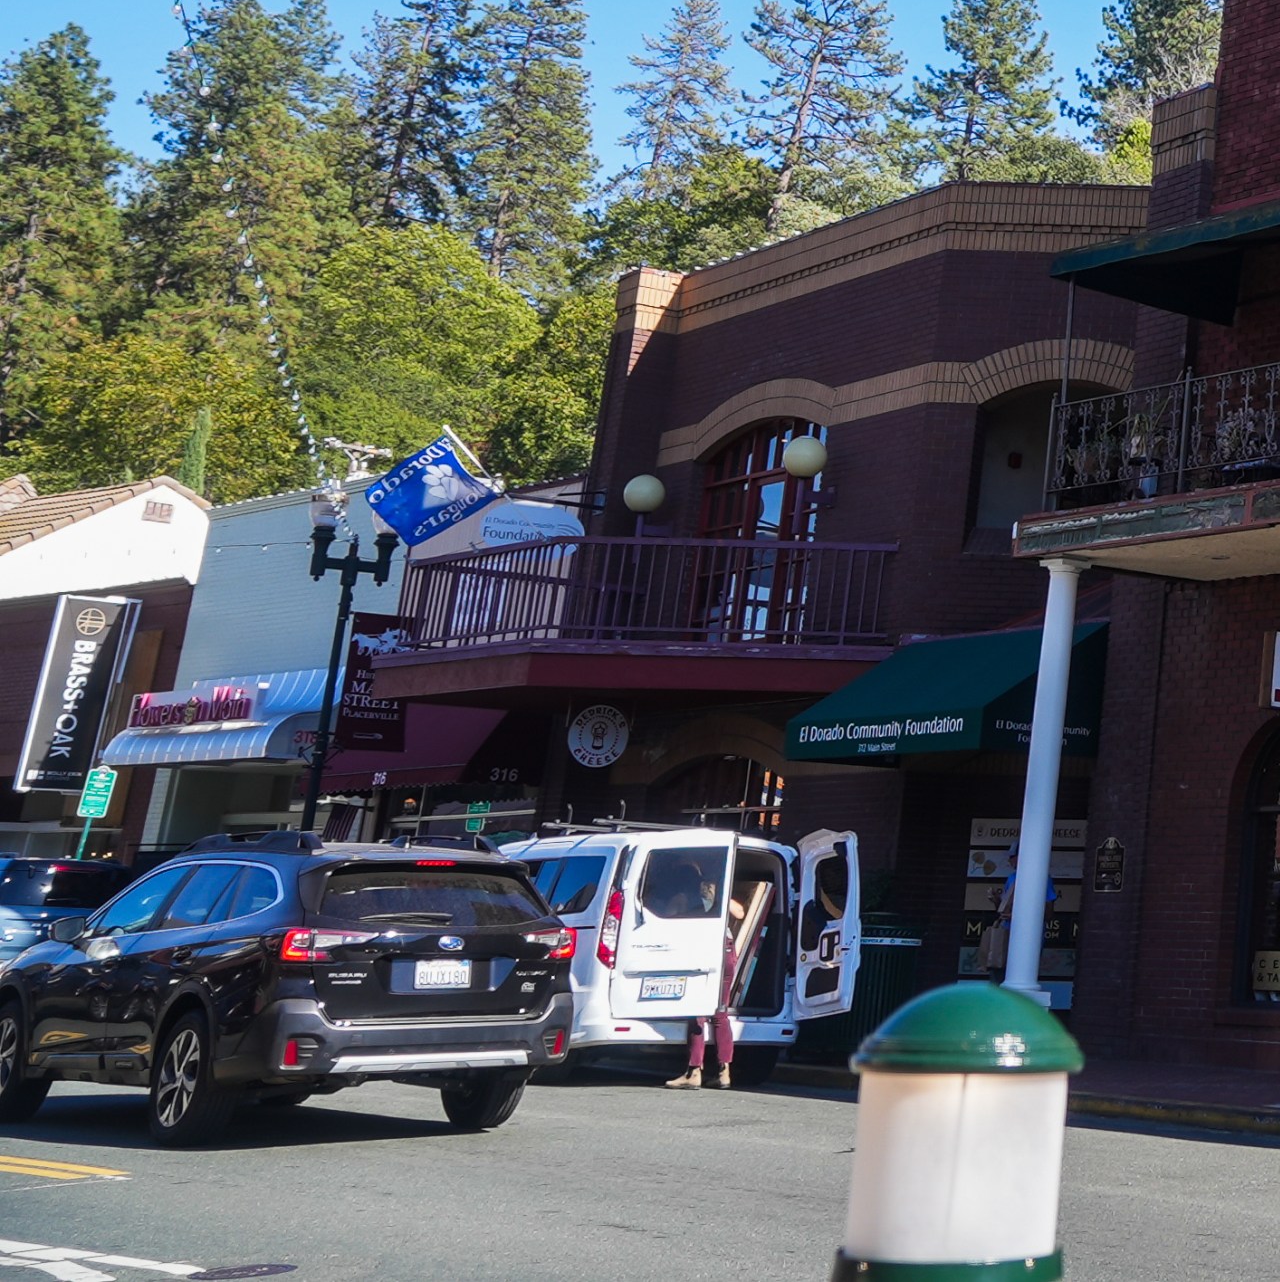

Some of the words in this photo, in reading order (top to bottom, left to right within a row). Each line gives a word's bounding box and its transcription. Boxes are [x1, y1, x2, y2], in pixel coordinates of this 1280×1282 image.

[799, 726, 809, 743] El
[810, 724, 845, 742] Dorado
[846, 721, 904, 740] Community
[905, 716, 964, 736] Foundation
[996, 719, 1004, 729] El
[867, 742, 880, 752] Main
[881, 742, 896, 751] Street
[573, 749, 620, 766] CHEESE
[372, 771, 387, 786] 316
[490, 768, 519, 782] 316
[990, 827, 1019, 837] DEDRI
[1054, 827, 1081, 839] HEESE
[1257, 973, 1263, 982] &
